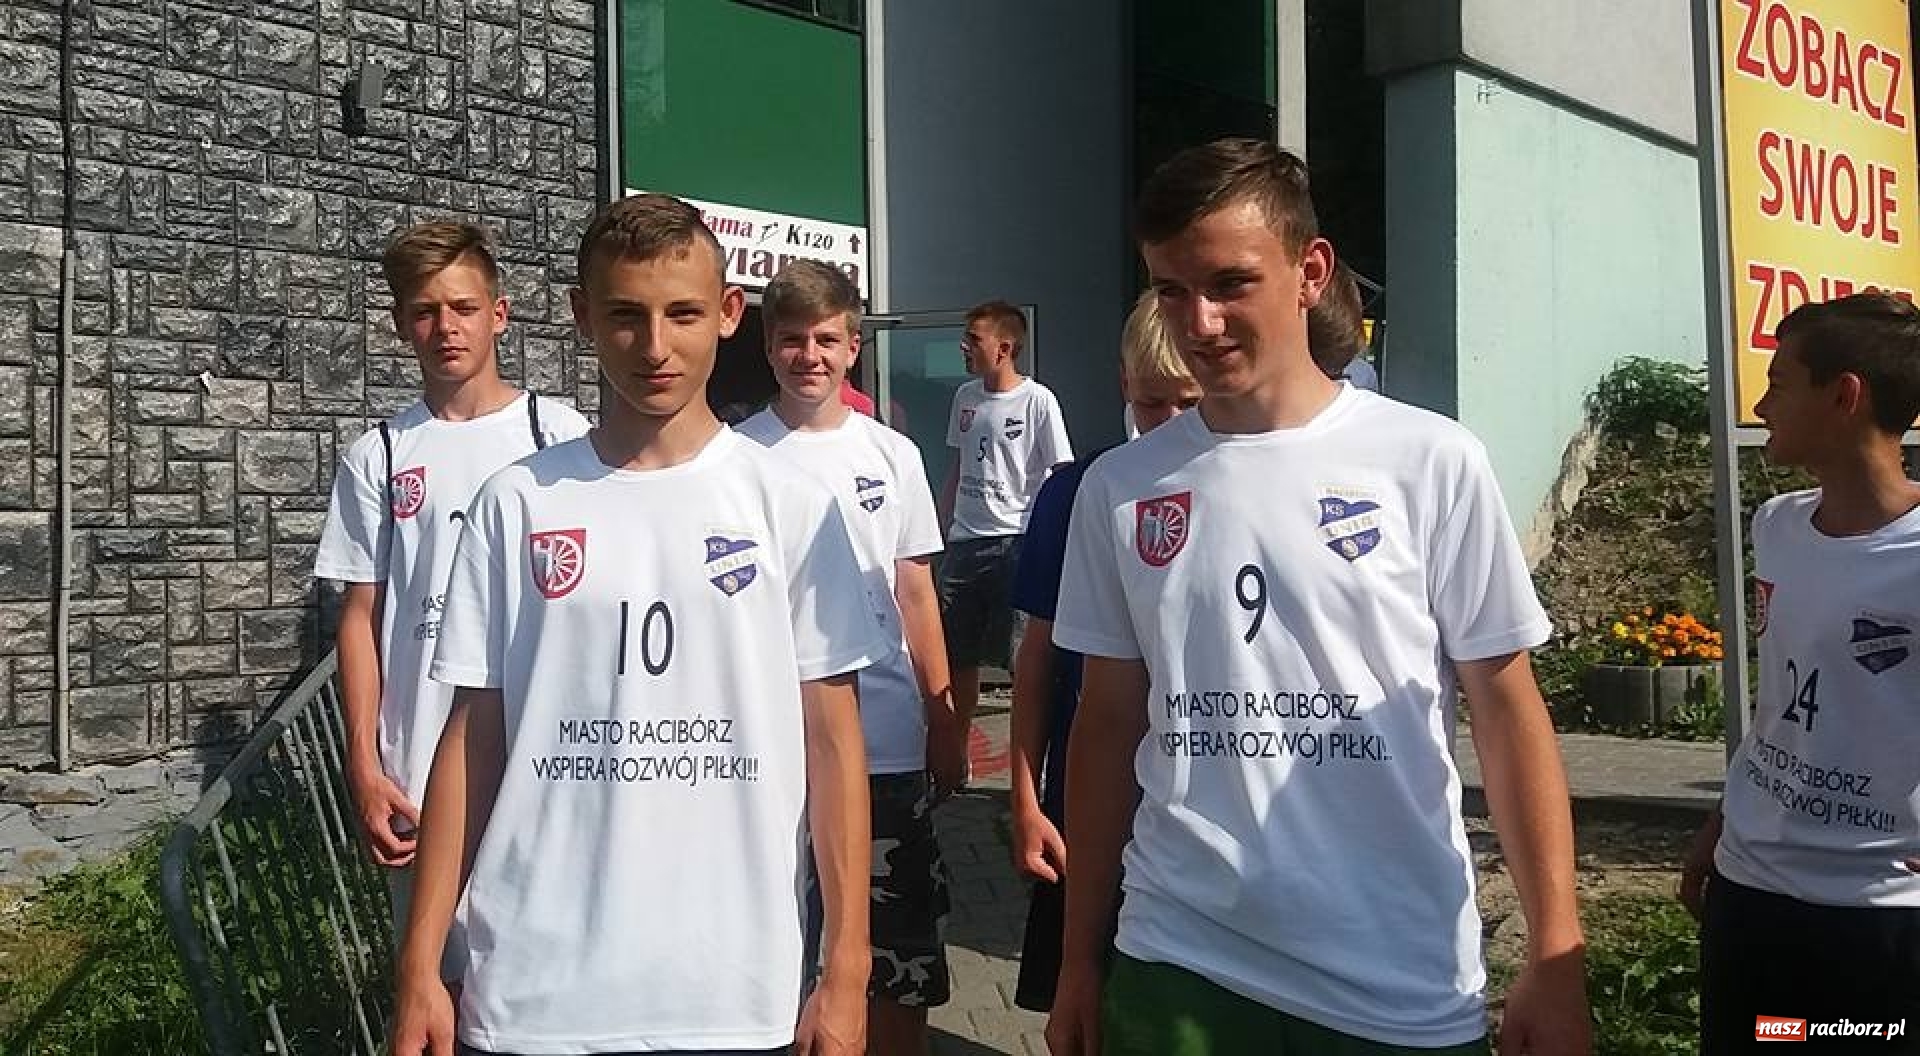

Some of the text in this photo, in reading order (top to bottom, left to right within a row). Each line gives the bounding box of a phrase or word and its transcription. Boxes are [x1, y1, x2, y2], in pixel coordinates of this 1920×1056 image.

[1736, 0, 1905, 129] ZOBACZ
[1758, 131, 1899, 244] SWOJE
[786, 223, 834, 250] K120
[617, 600, 674, 676] 10
[1236, 563, 1267, 645] 9
[559, 713, 733, 745] MIASTO RACIBÓRZ
[1165, 687, 1363, 721] MIASTO RACIBÓRZ
[1782, 658, 1820, 733] 24
[531, 750, 760, 787] WSPIERA ROZWÓJ PIŁKI!!
